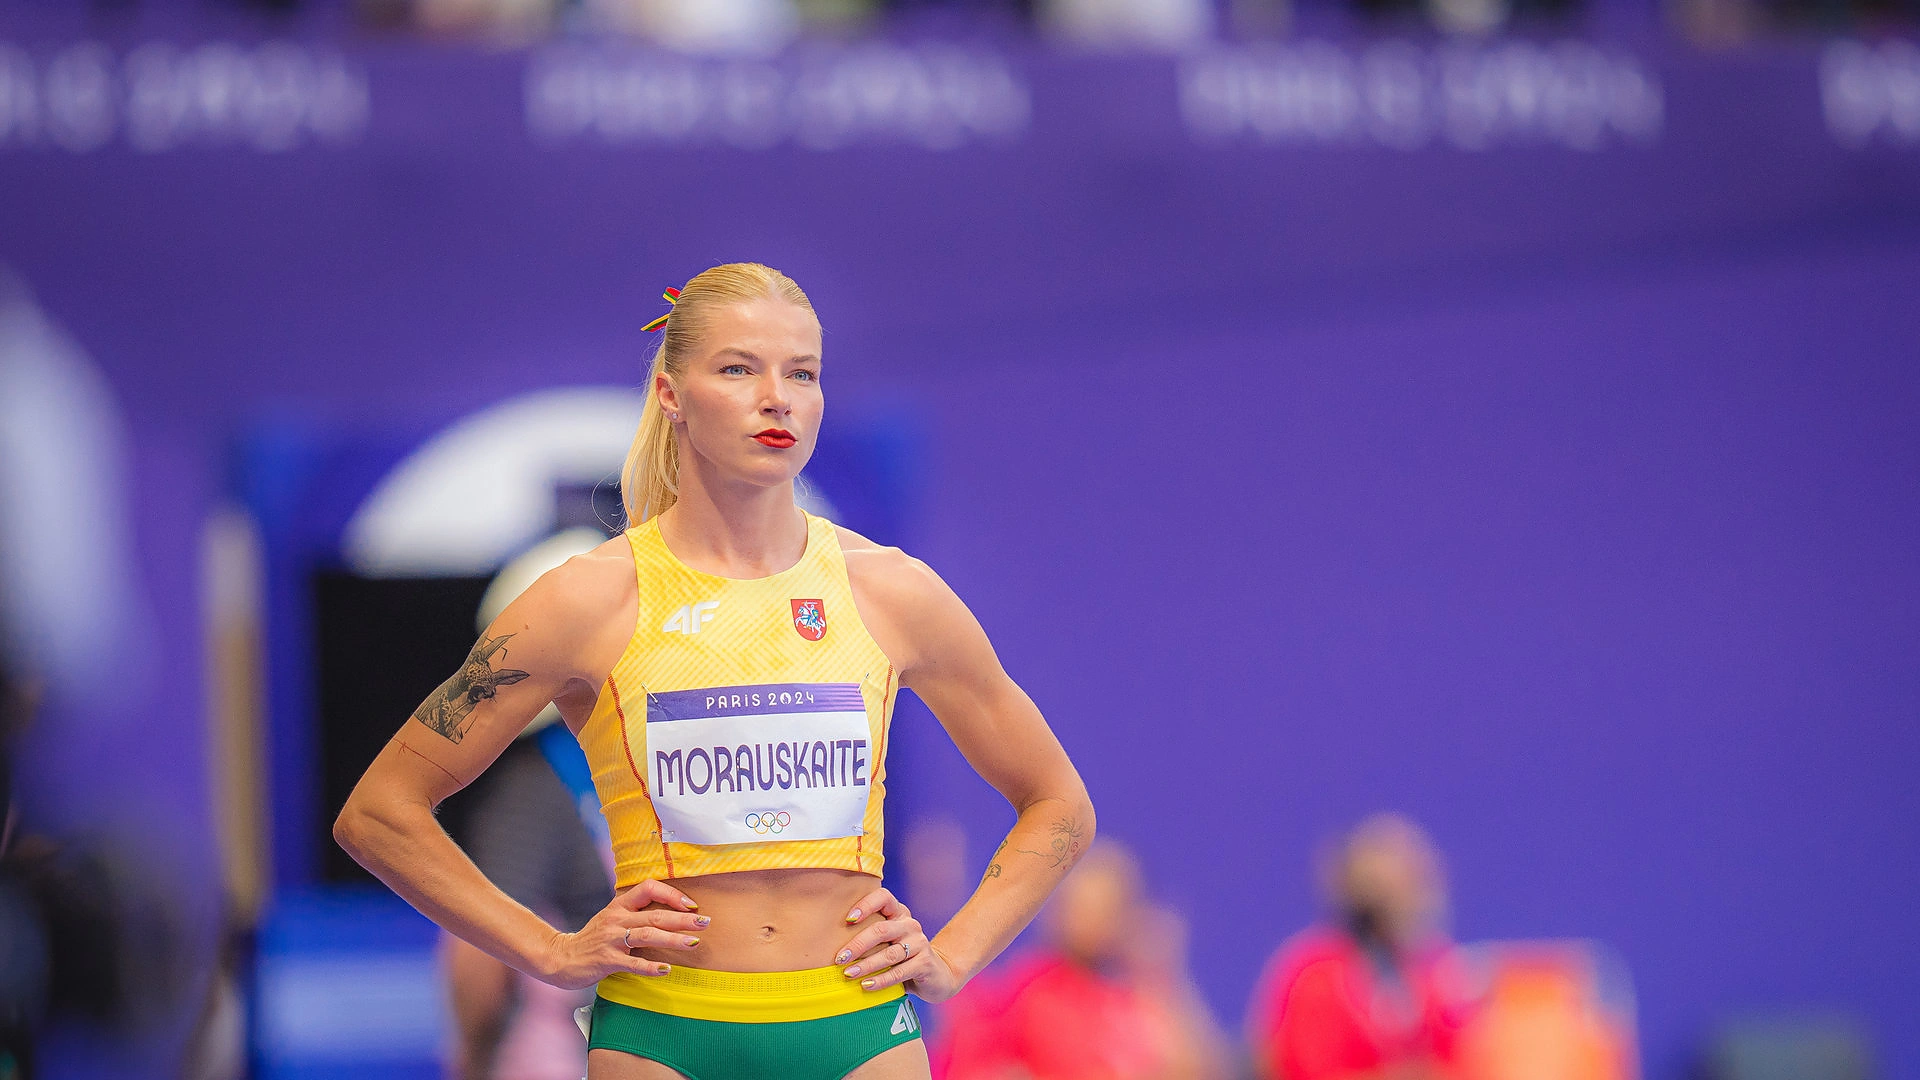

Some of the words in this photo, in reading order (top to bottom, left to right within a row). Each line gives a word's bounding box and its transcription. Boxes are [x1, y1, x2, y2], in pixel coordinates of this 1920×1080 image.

[662, 600, 720, 635] 4F
[768, 691, 815, 706] 2024
[656, 739, 867, 797] MORAUSKAITE
